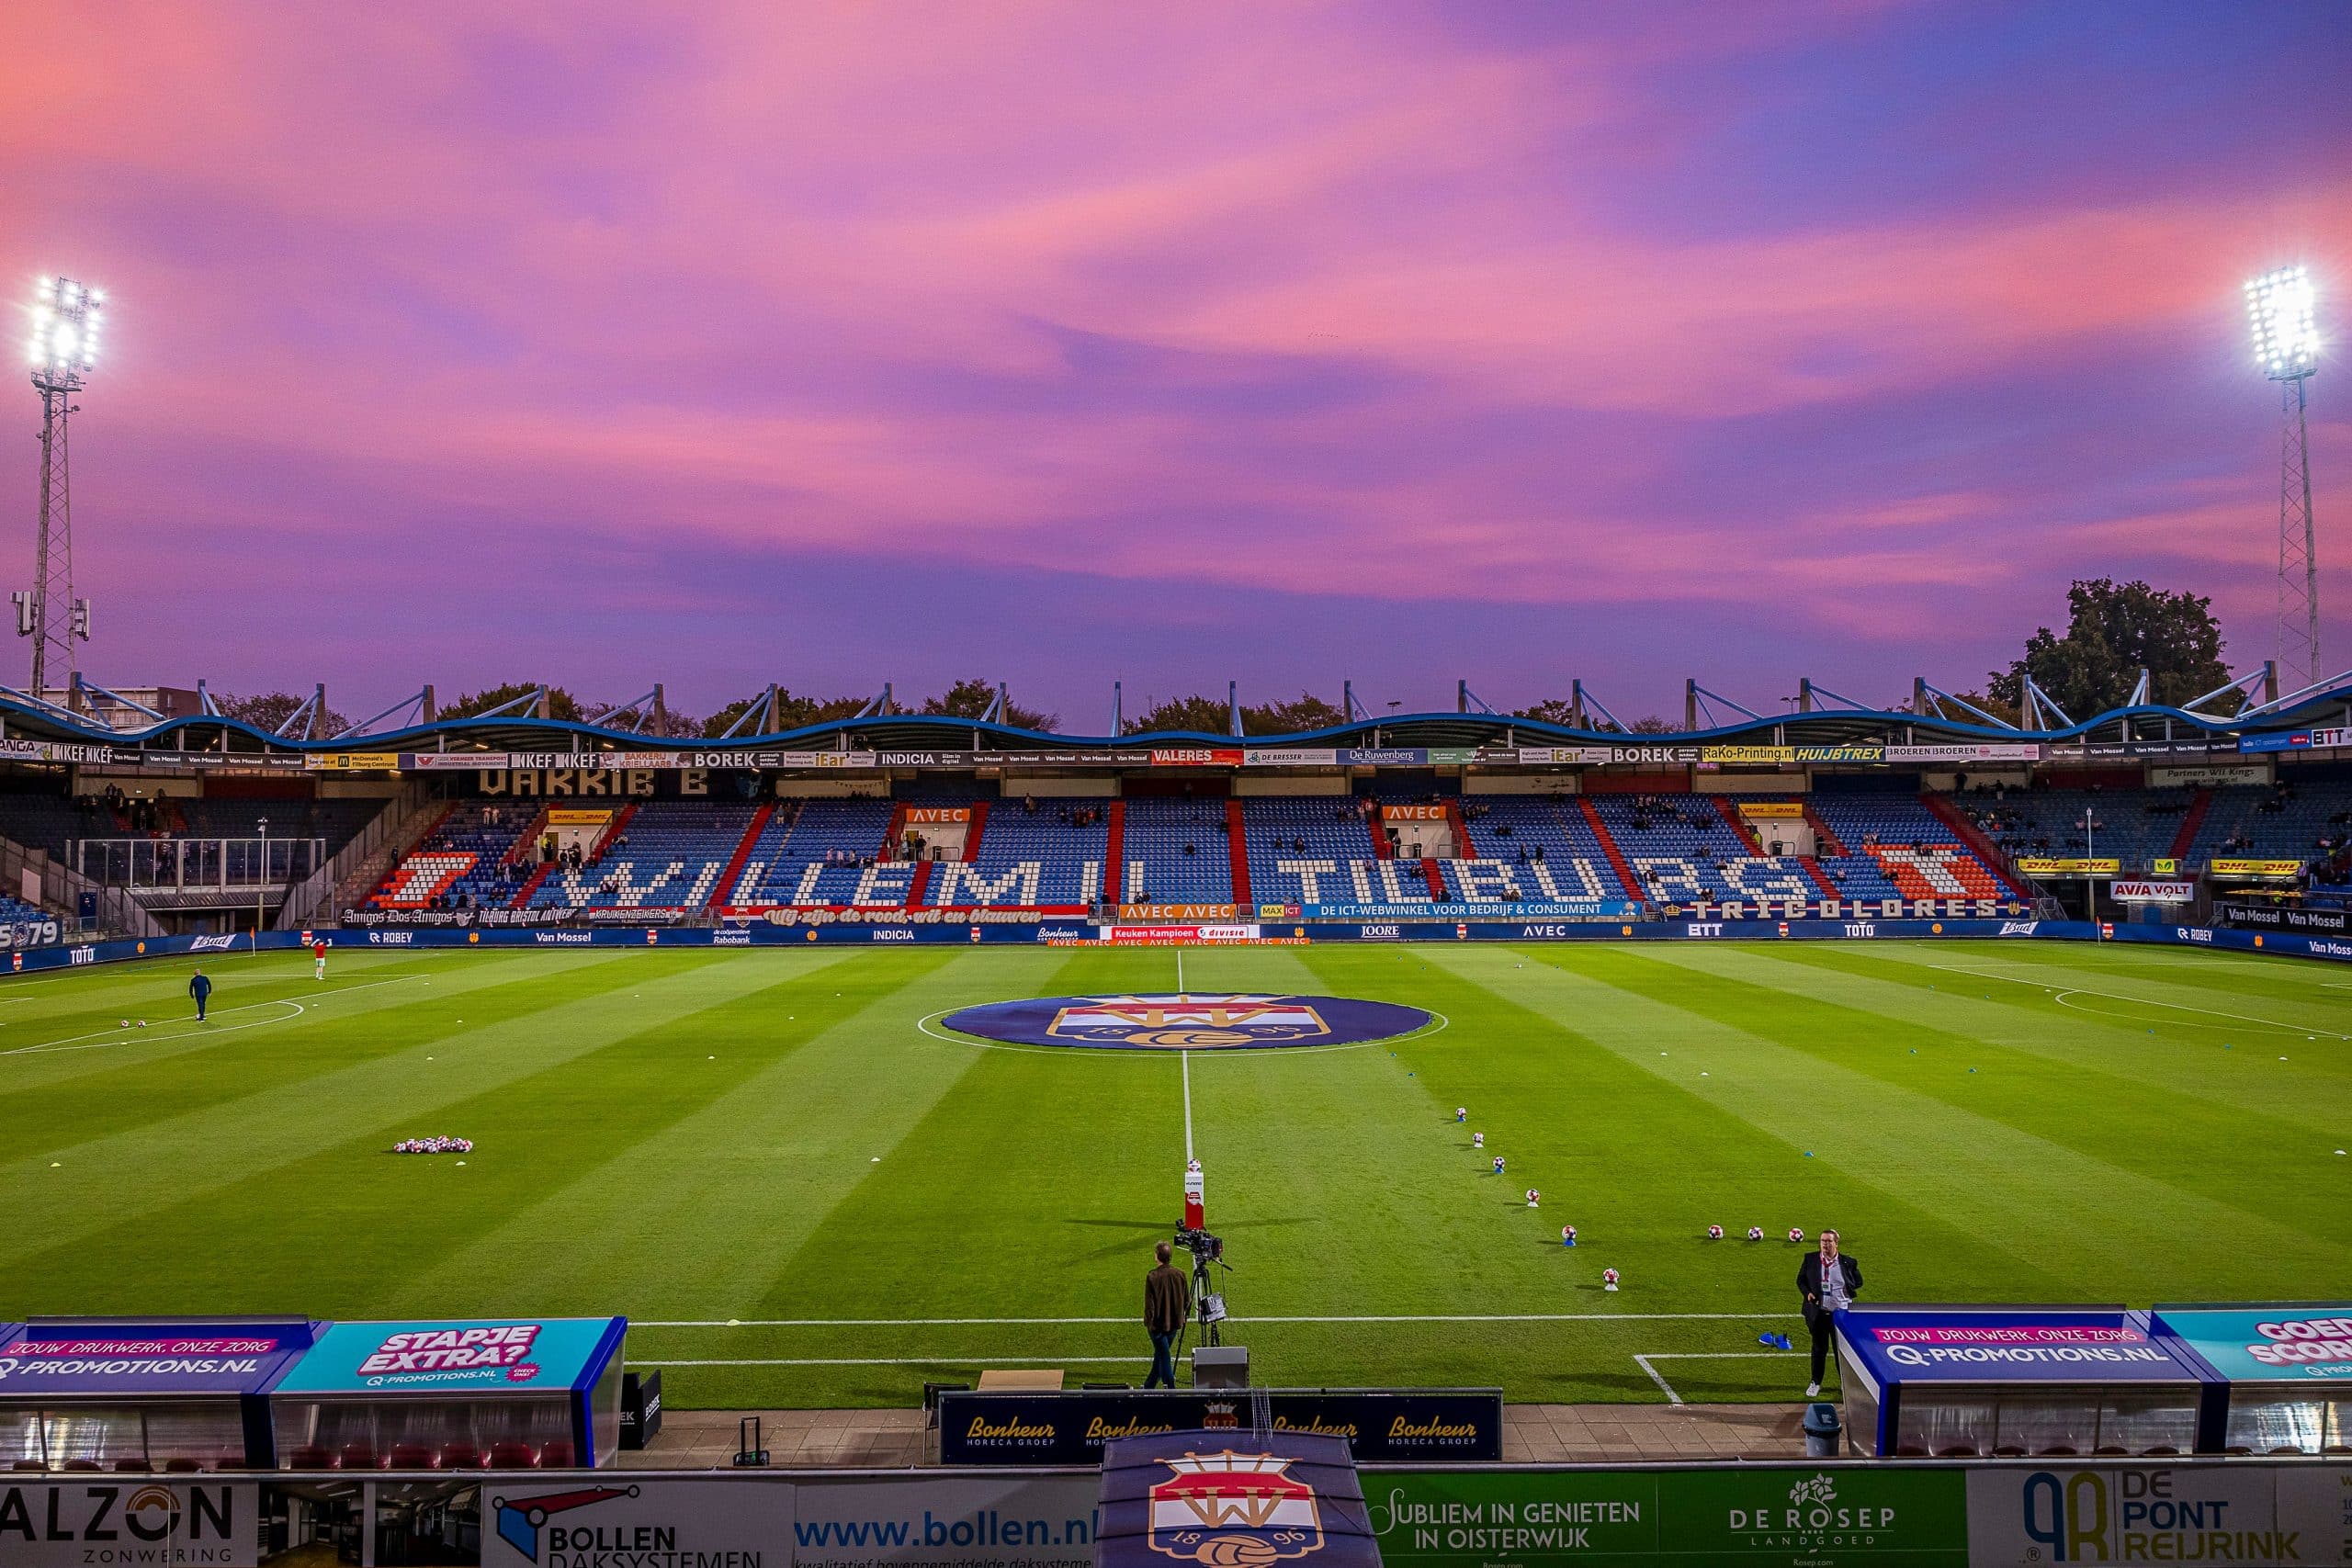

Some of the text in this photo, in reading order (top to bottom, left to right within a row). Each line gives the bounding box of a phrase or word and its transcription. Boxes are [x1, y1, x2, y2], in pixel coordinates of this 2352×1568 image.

[1153, 750, 1213, 761] VALERES
[1350, 750, 1414, 761] De Ruwenberg
[1614, 748, 1675, 762] BOREK
[1703, 748, 1793, 761] RaKo-Printing.nl
[1795, 748, 1883, 761] HUIJBTREX
[1932, 747, 1976, 755] BROEREN
[695, 753, 755, 767] BOREK
[882, 753, 935, 764] INDICIA
[913, 809, 963, 822] AVEC
[1389, 807, 1439, 819] AVEC
[2219, 862, 2250, 871] DHL
[2154, 885, 2189, 897] VOLT
[595, 908, 667, 919] KRUIKENZEIKERS
[1125, 906, 1230, 918] AVEC AVEC
[1262, 906, 1299, 916] MAX ICT
[1321, 904, 1601, 917] DE ICT-WEBWINKEL VOOR BEDRIJF & CONSUMENT
[1691, 899, 1996, 919] TRICOLORES
[2229, 908, 2280, 923] Van Mossel
[479, 909, 509, 923] TILBURG
[801, 909, 836, 926] zijn
[839, 908, 862, 921] de
[912, 908, 943, 922] wit
[944, 911, 967, 922] en
[2287, 911, 2345, 929] Van Mossel
[1037, 927, 1079, 938] Bonheur
[1115, 930, 1148, 938] Keuken
[1150, 929, 1194, 939] Kampioen
[1362, 926, 1399, 936] JOORE
[1523, 926, 1566, 935] AVEC
[1689, 923, 1723, 936] BTT
[1845, 920, 1874, 936] TOTO
[382, 932, 413, 943] ROBEY
[537, 932, 592, 942] Van Mossel
[713, 936, 751, 944] Rabobank
[873, 931, 914, 940] INDICIA
[2191, 928, 2212, 942] ROBEY
[2310, 941, 2326, 952] Van
[70, 946, 95, 964] TOTO
[379, 1325, 540, 1351] STAPJE
[1880, 1329, 1930, 1341] JOUW
[2037, 1329, 2089, 1341] ONZE
[2095, 1329, 2138, 1341] ZORG
[9, 1341, 270, 1354] JOUW DRUKWERK, ONZE ZORG
[362, 1345, 526, 1372] EXTRA?
[1886, 1345, 2170, 1366] Q-PROMOTIONS.NL
[0, 1358, 258, 1380] Q-PROMOTIONS.NL
[367, 1371, 496, 1386] Q-PROMOTIONS.NL
[645, 1393, 661, 1416] BOREK
[967, 1416, 1056, 1438] Bonheur
[1389, 1416, 1477, 1438] Bonheur
[2122, 1471, 2172, 1497] DE
[1368, 1488, 1640, 1536] SUBLIEM IN GENIETEN
[1730, 1508, 1895, 1529] DE ROSEP
[2123, 1501, 2229, 1529] PONT
[549, 1527, 676, 1551] BOLLEN
[1172, 1527, 1306, 1547] 18 96
[1415, 1529, 1589, 1551] IN OISTERWIJK
[1751, 1536, 1875, 1546] LANDGOED
[2124, 1531, 2301, 1561] REIJRINK
[84, 1548, 232, 1564] ZONWERING
[549, 1551, 761, 1568] DAKSYSTEMEN
[1793, 1558, 1834, 1568] Rosep.com
